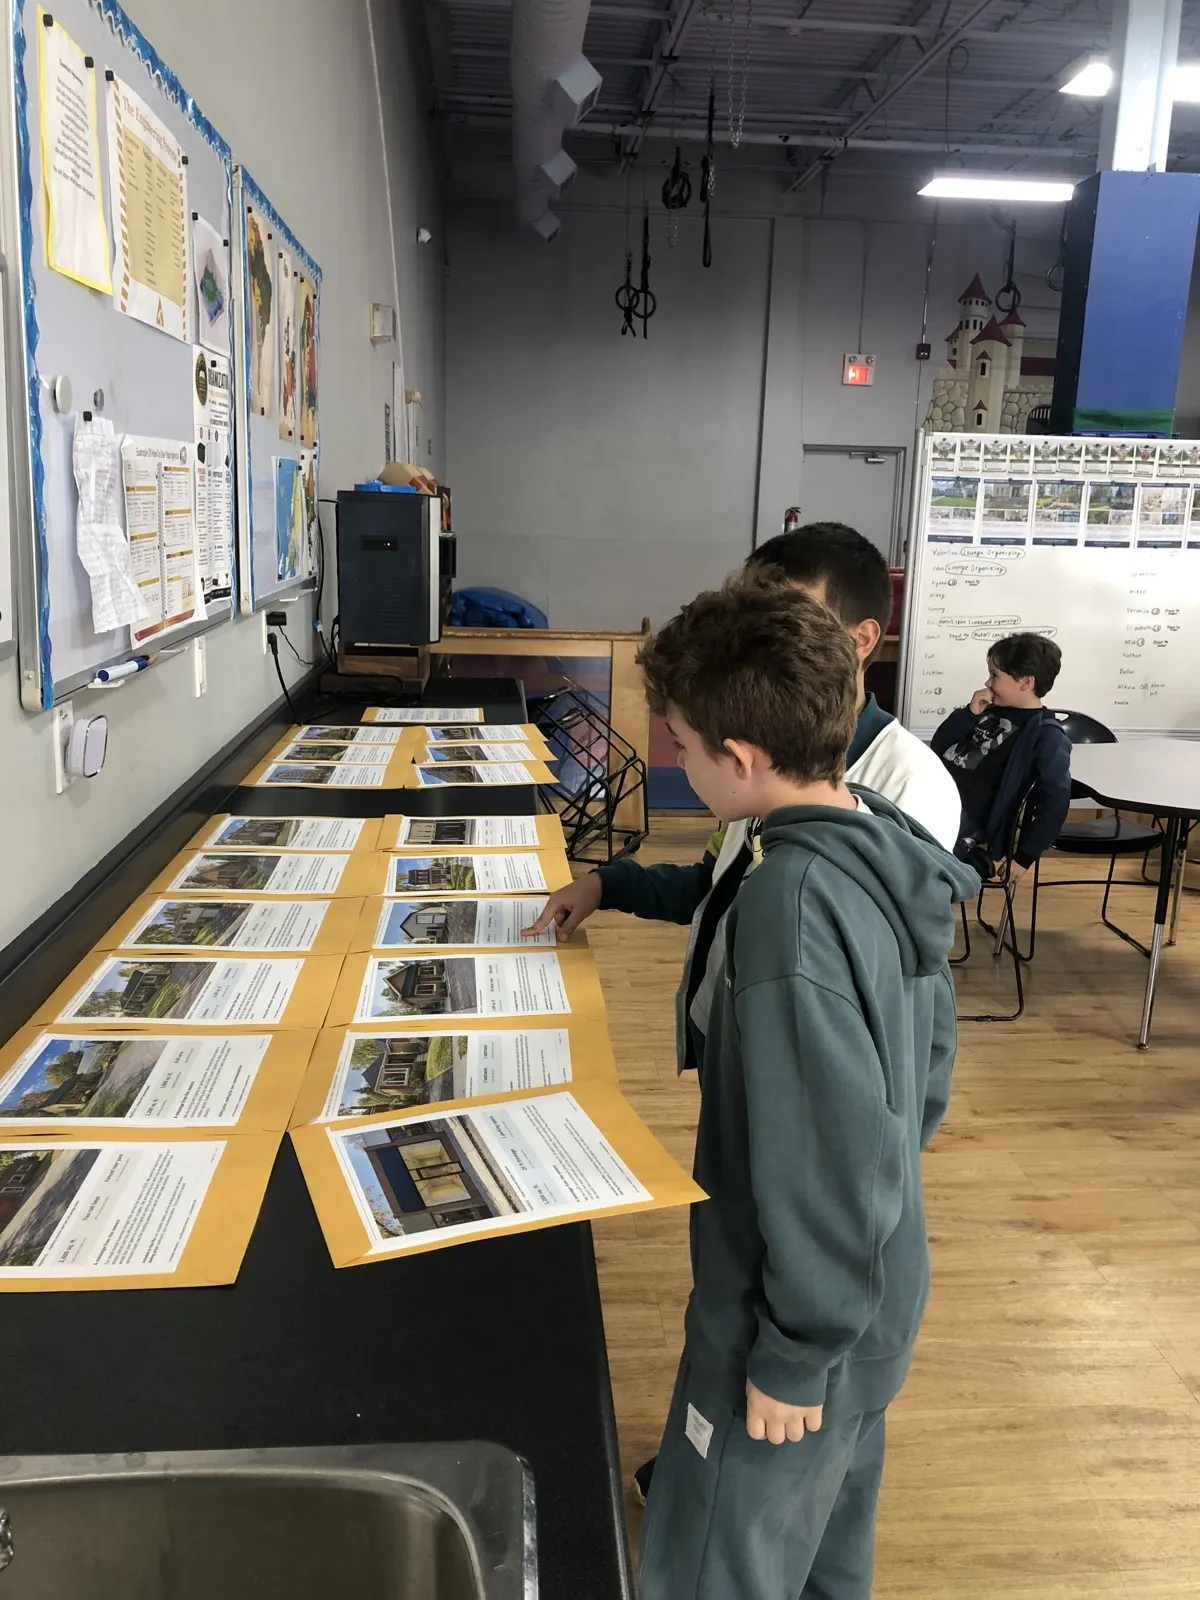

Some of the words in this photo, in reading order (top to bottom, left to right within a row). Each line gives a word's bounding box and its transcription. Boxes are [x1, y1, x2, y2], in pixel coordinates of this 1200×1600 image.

[123, 95, 135, 117] The
[962, 547, 984, 558] Lounge
[986, 547, 1022, 559] Organizing
[946, 564, 969, 574] Lounge
[970, 563, 1004, 574] Organizing
